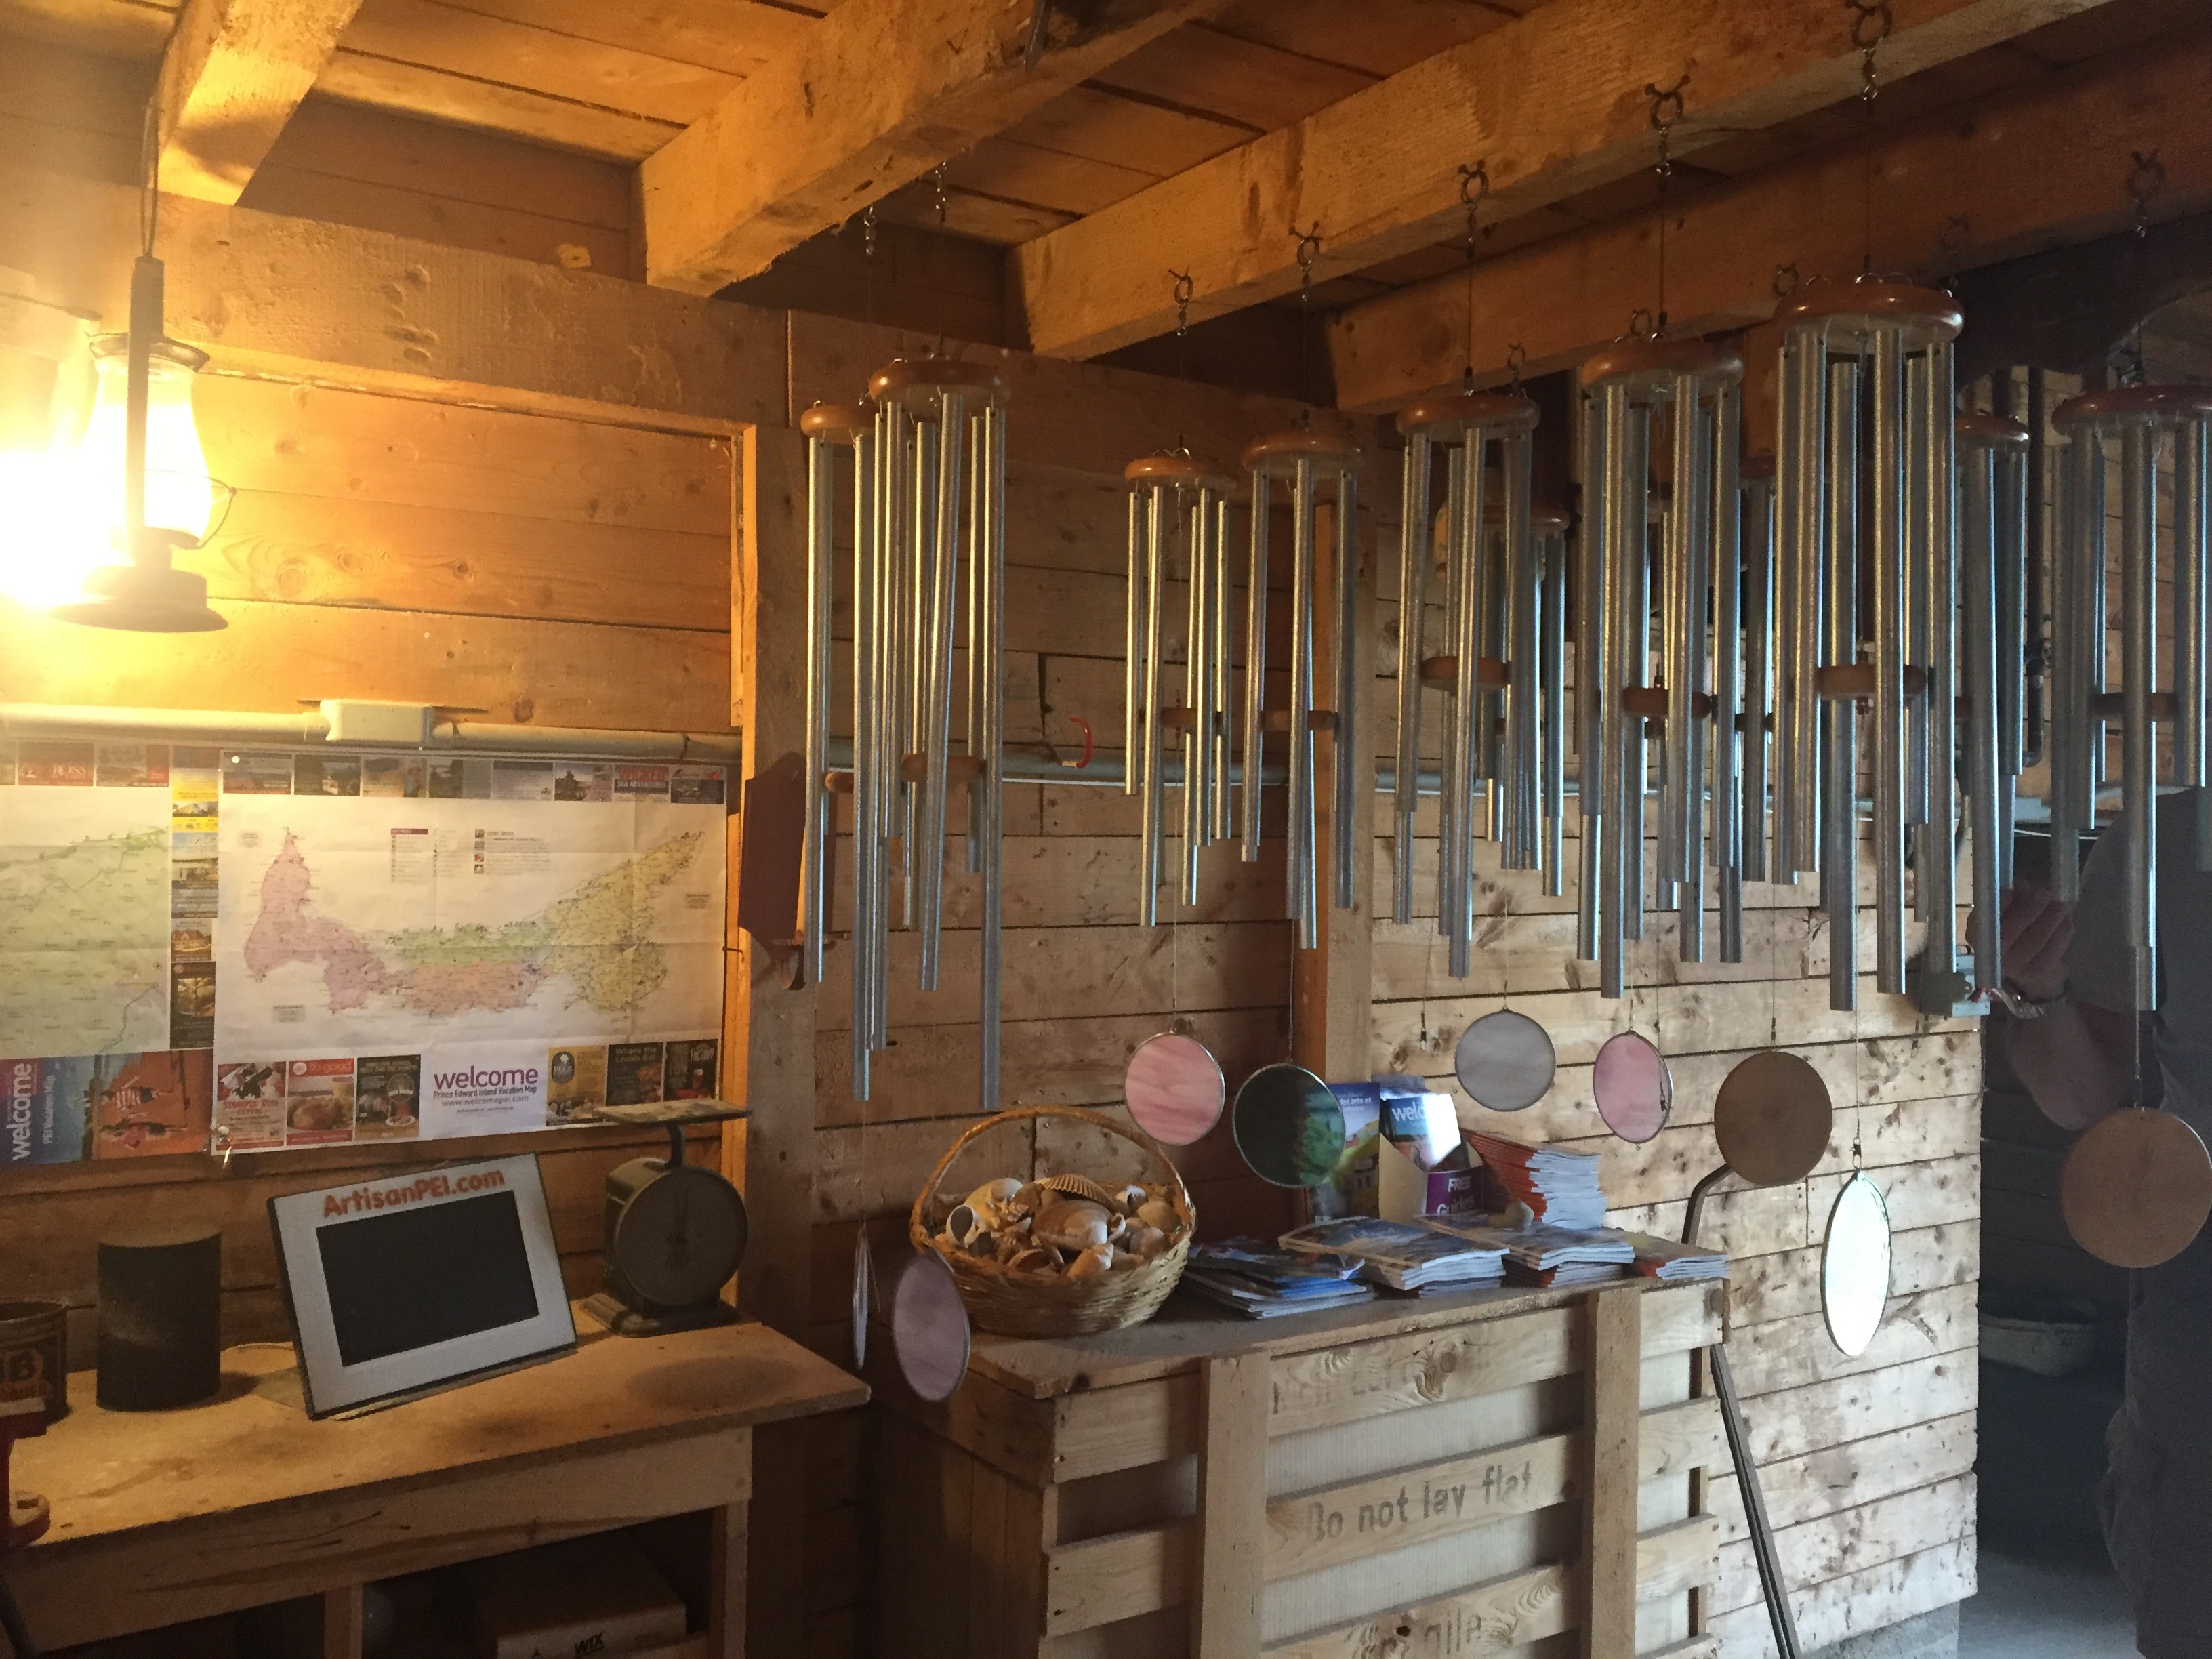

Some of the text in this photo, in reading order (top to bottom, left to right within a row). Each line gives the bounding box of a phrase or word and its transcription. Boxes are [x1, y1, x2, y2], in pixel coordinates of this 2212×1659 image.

[433, 1065, 539, 1090] welcome
[433, 1086, 537, 1099] Prince Edward Island Vacation Map
[5, 1063, 33, 1161] welcome
[323, 1169, 506, 1218] ArtisanPEI.com
[1448, 1174, 1473, 1193] FREE
[1307, 1460, 1532, 1542] Do not lay flat
[574, 1630, 605, 1655] WIX
